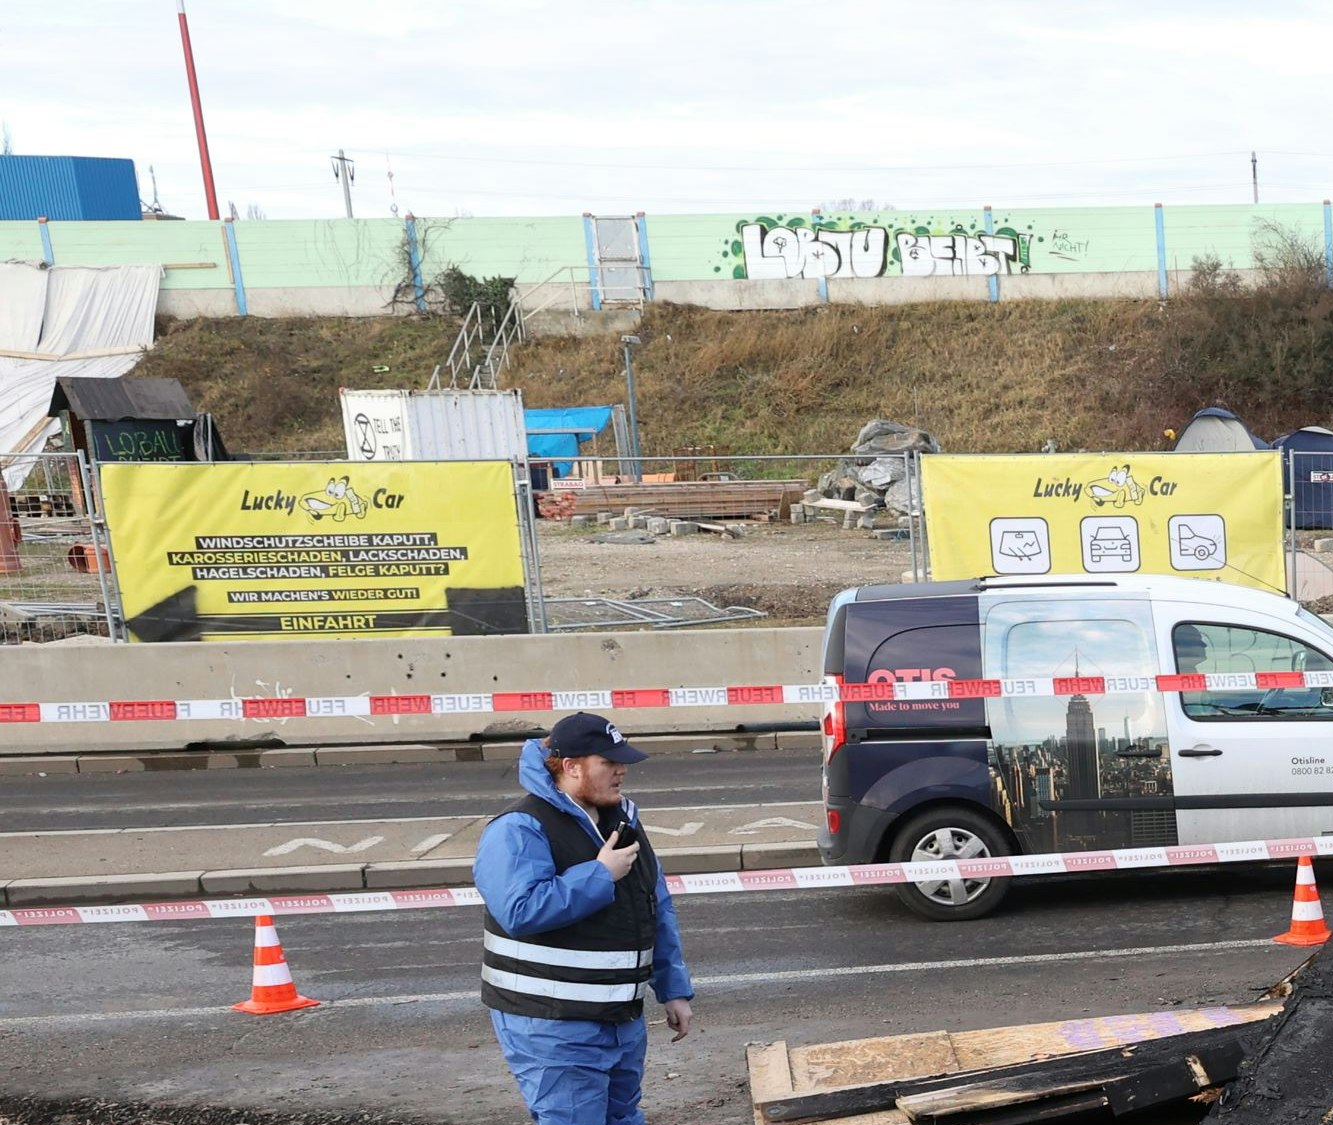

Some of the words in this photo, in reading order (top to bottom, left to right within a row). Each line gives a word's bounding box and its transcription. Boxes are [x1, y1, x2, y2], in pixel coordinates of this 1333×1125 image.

[1034, 477, 1083, 503] Lucky
[1149, 475, 1178, 497] Car
[241, 488, 297, 516] Lucky
[373, 485, 405, 509] Car
[199, 534, 370, 550] WINDSCHUTZSCHEIBE
[372, 533, 435, 549] KAPUTT,
[171, 549, 348, 565] KAROSSERIESCHADEN,
[349, 548, 465, 563] LACKSCHADEN,
[196, 566, 327, 581] HAGELSCHADEN,
[328, 564, 376, 577] FELGE
[378, 562, 446, 577] KAPUTT?
[230, 592, 259, 602] WIR
[261, 590, 329, 602] MACHEN'S
[331, 588, 384, 600] WIEDER
[386, 587, 417, 600] GUT!
[280, 615, 377, 631] EINFAHRT
[870, 702, 896, 712] Made
[900, 702, 909, 712] to
[912, 702, 940, 711] move
[941, 701, 960, 712] you
[1291, 757, 1325, 766] Otisline
[1291, 767, 1312, 776] 0800
[1314, 767, 1324, 775] 82
